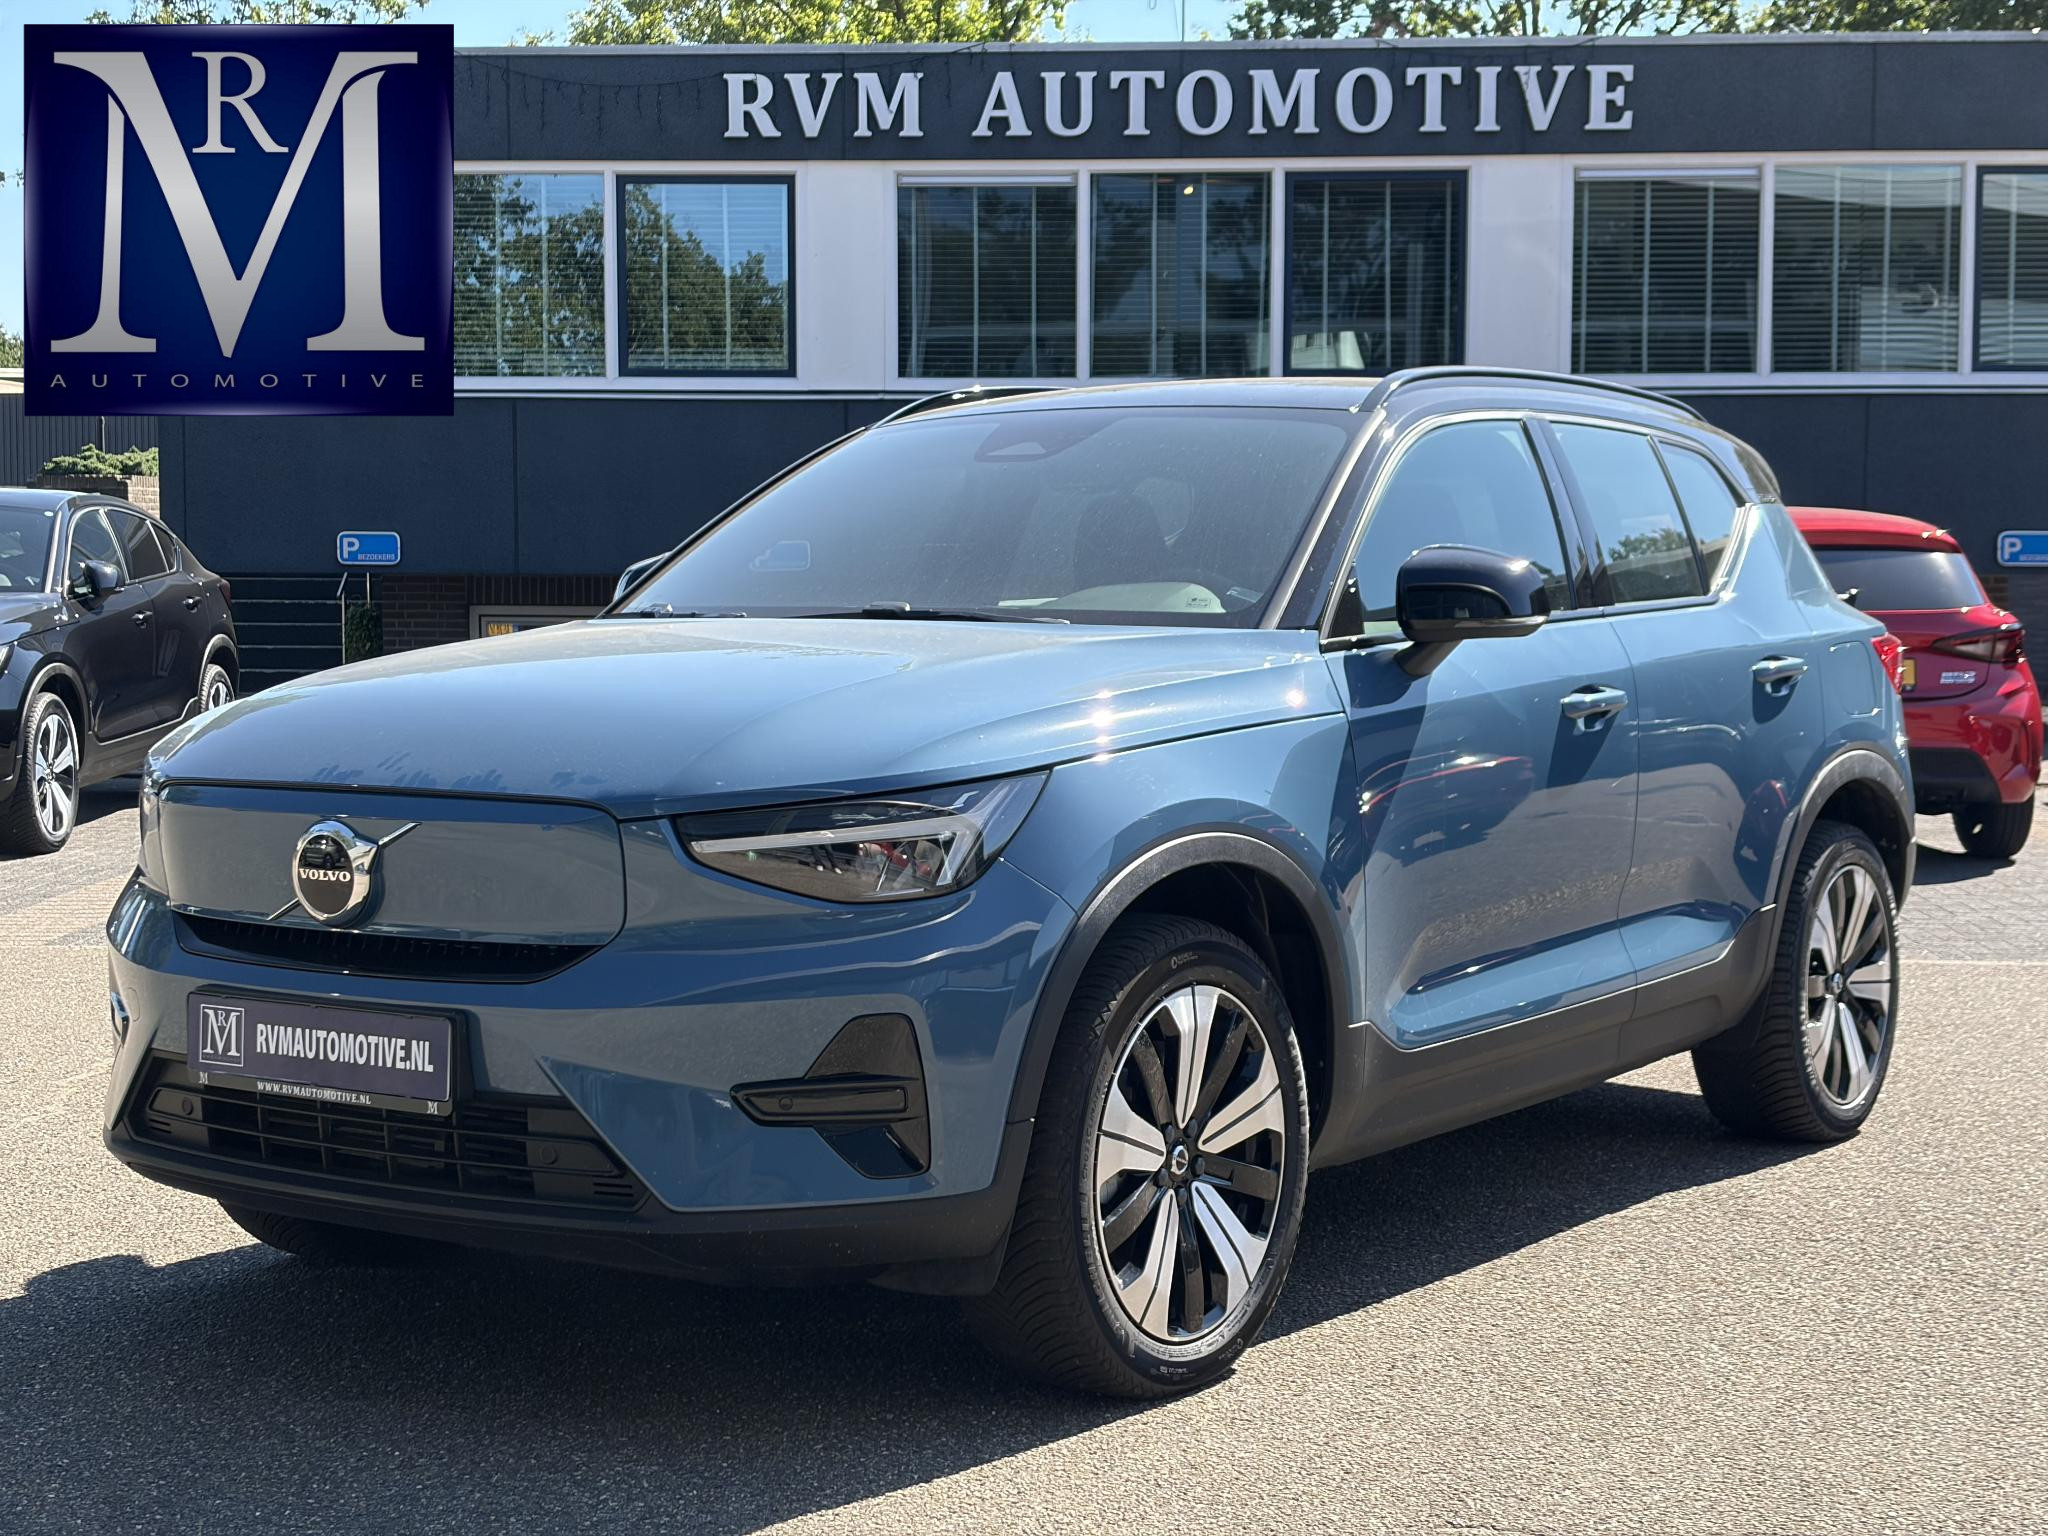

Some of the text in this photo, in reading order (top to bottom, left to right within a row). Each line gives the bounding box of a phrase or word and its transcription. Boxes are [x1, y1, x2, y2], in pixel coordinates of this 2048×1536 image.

[723, 64, 1636, 139] RVM AUTOMOTIVE
[342, 537, 360, 560] P
[2003, 537, 2022, 560] P
[299, 868, 351, 882] VOLVO
[256, 1023, 435, 1073] RVMAUTOMOTIVE.NL
[256, 1081, 372, 1105] WWW.RVMAUTOMOTIVE.NL
